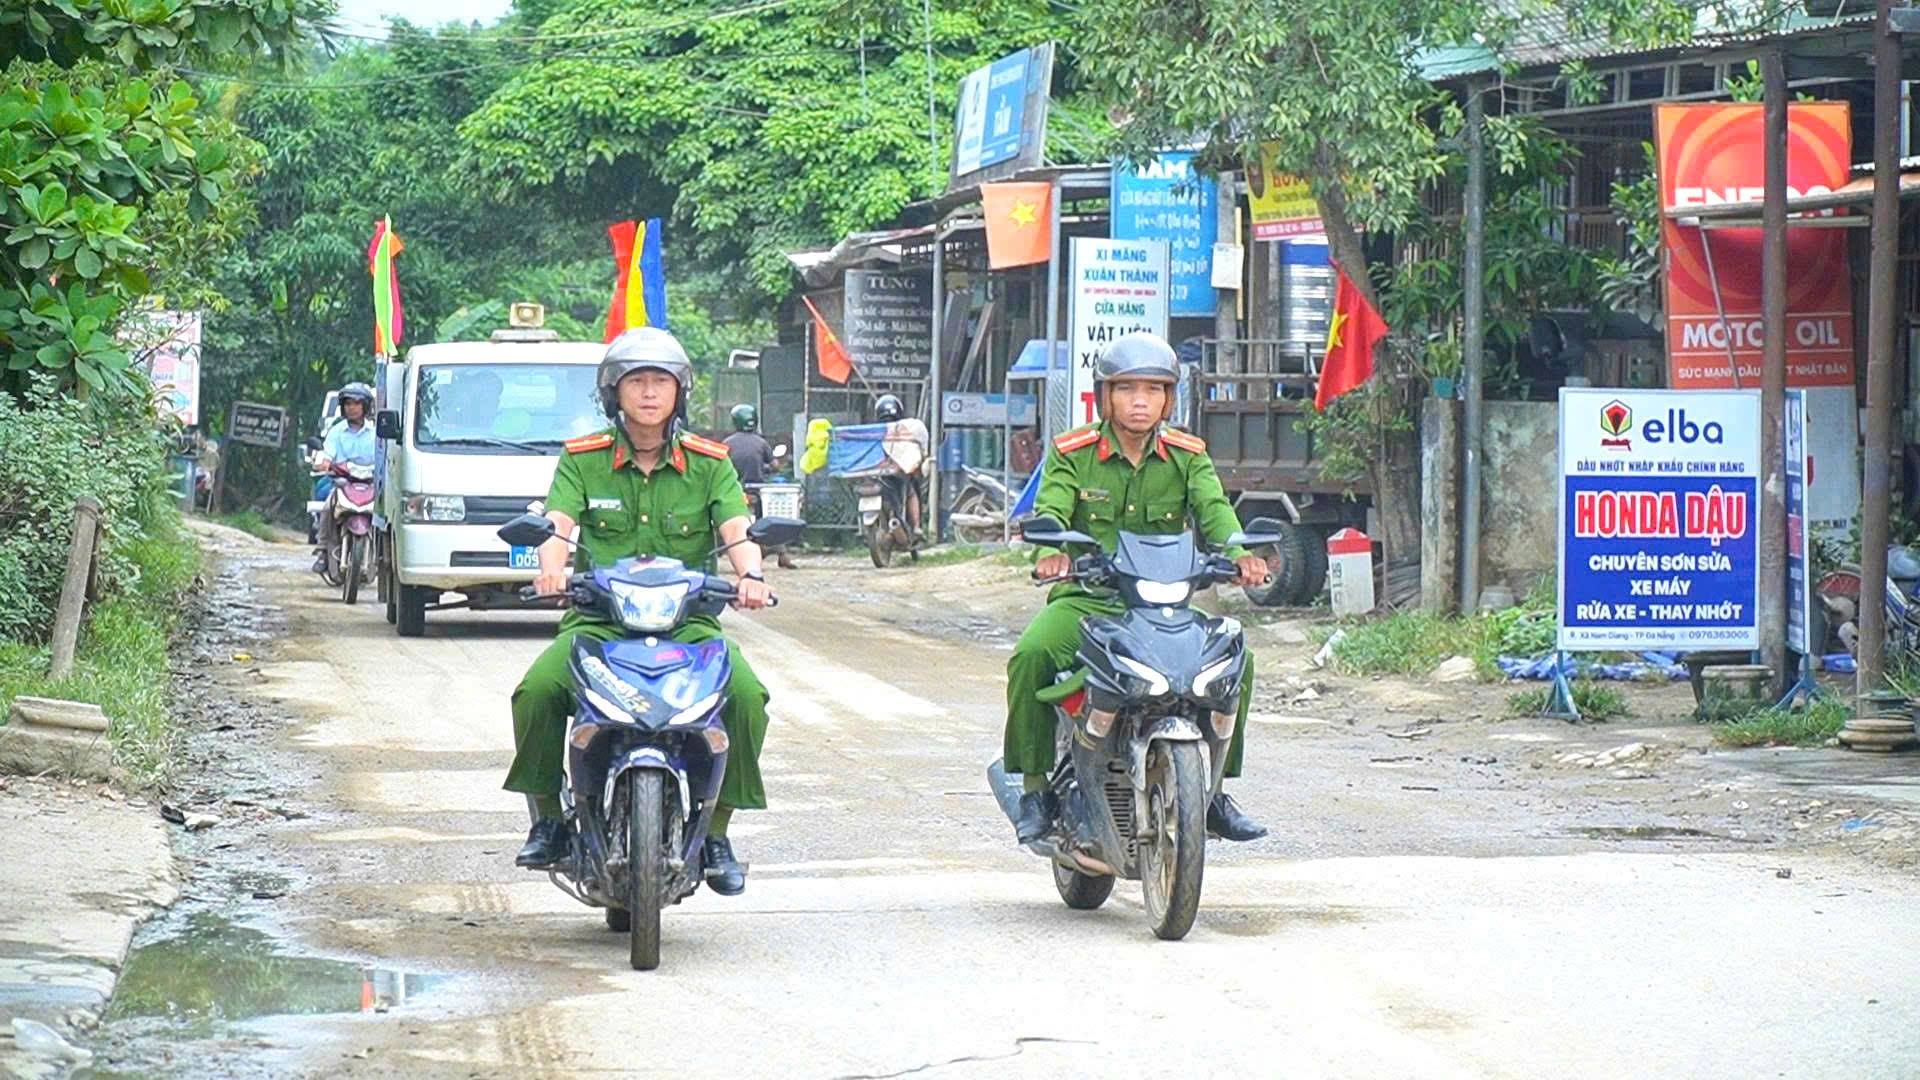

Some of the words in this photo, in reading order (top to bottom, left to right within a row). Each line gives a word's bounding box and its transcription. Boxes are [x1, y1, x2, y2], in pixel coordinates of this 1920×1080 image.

[1096, 249, 1108, 260] XI
[1112, 247, 1147, 262] MĂNG
[1084, 266, 1116, 282] XUÂN
[1095, 300, 1115, 315] CỬA
[1118, 301, 1145, 316] HÀNG
[1087, 322, 1115, 346] VẬT
[1682, 321, 1788, 349] MOTO
[1795, 320, 1840, 347] OIL
[1642, 408, 1724, 445] elba
[1577, 456, 1597, 472] DẦU
[1628, 458, 1654, 474] NHẬP
[1719, 458, 1745, 473] HÀNG
[1576, 491, 1679, 537] HONDA
[1685, 484, 1746, 546] DẬU
[1588, 550, 1660, 571] CHUYÊN
[1661, 554, 1696, 571] SƠN
[1698, 550, 1731, 571] SỬA
[1630, 580, 1651, 595] XE
[1654, 575, 1691, 595] MÁY
[1577, 599, 1611, 620] RỬA
[1615, 604, 1636, 620] XE
[1649, 604, 1692, 620] THAY
[1695, 601, 1742, 620] NHỚT
